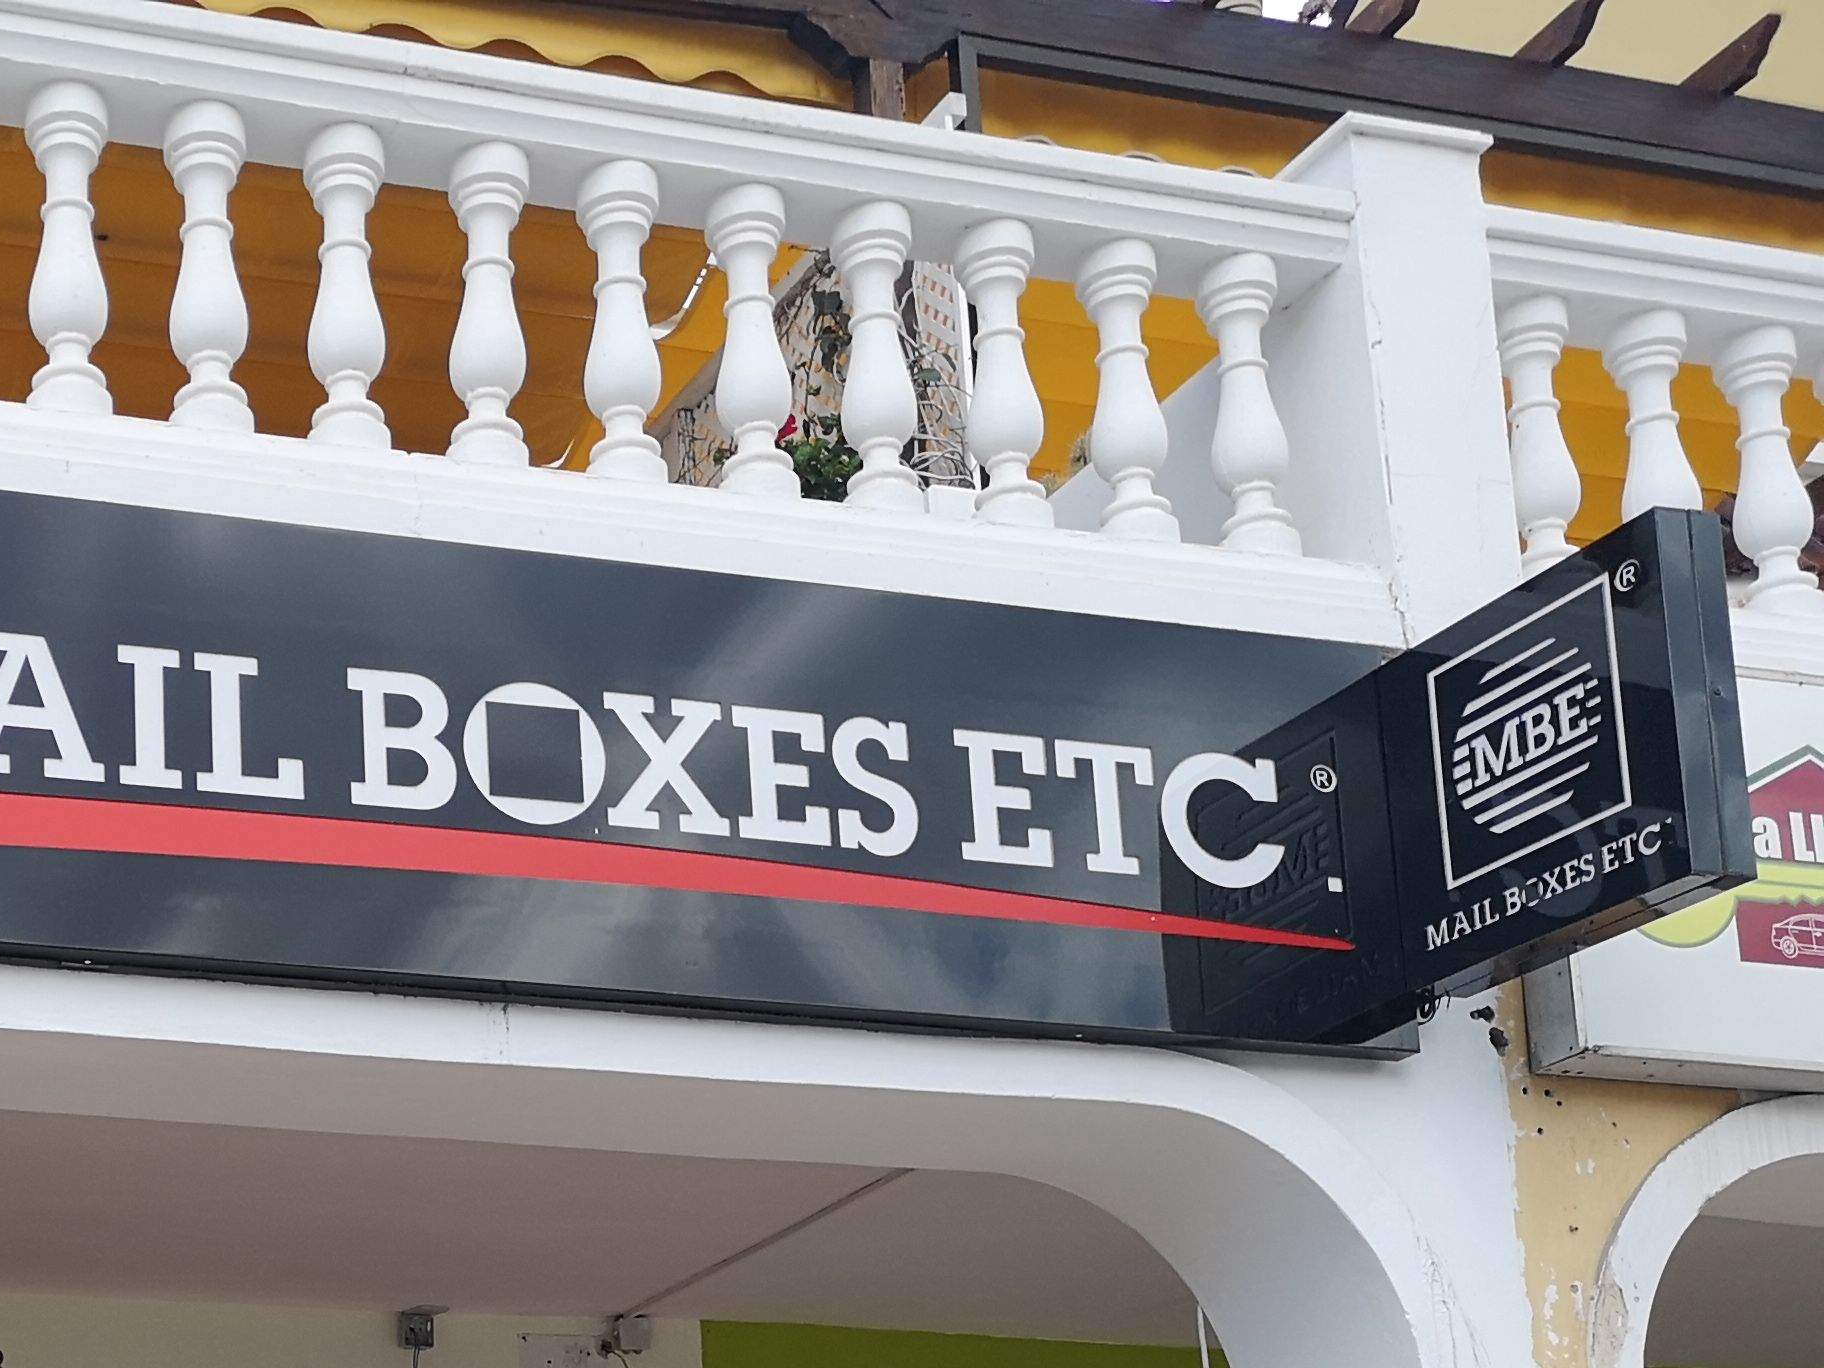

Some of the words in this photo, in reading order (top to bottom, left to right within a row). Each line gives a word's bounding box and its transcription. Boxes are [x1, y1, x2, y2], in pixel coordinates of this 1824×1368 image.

[346, 667, 918, 857] BOXES
[1471, 682, 1587, 788] MBE
[1424, 897, 1499, 951] MAIL
[1502, 853, 1595, 917] BOXES
[1601, 822, 1661, 874] ETC
